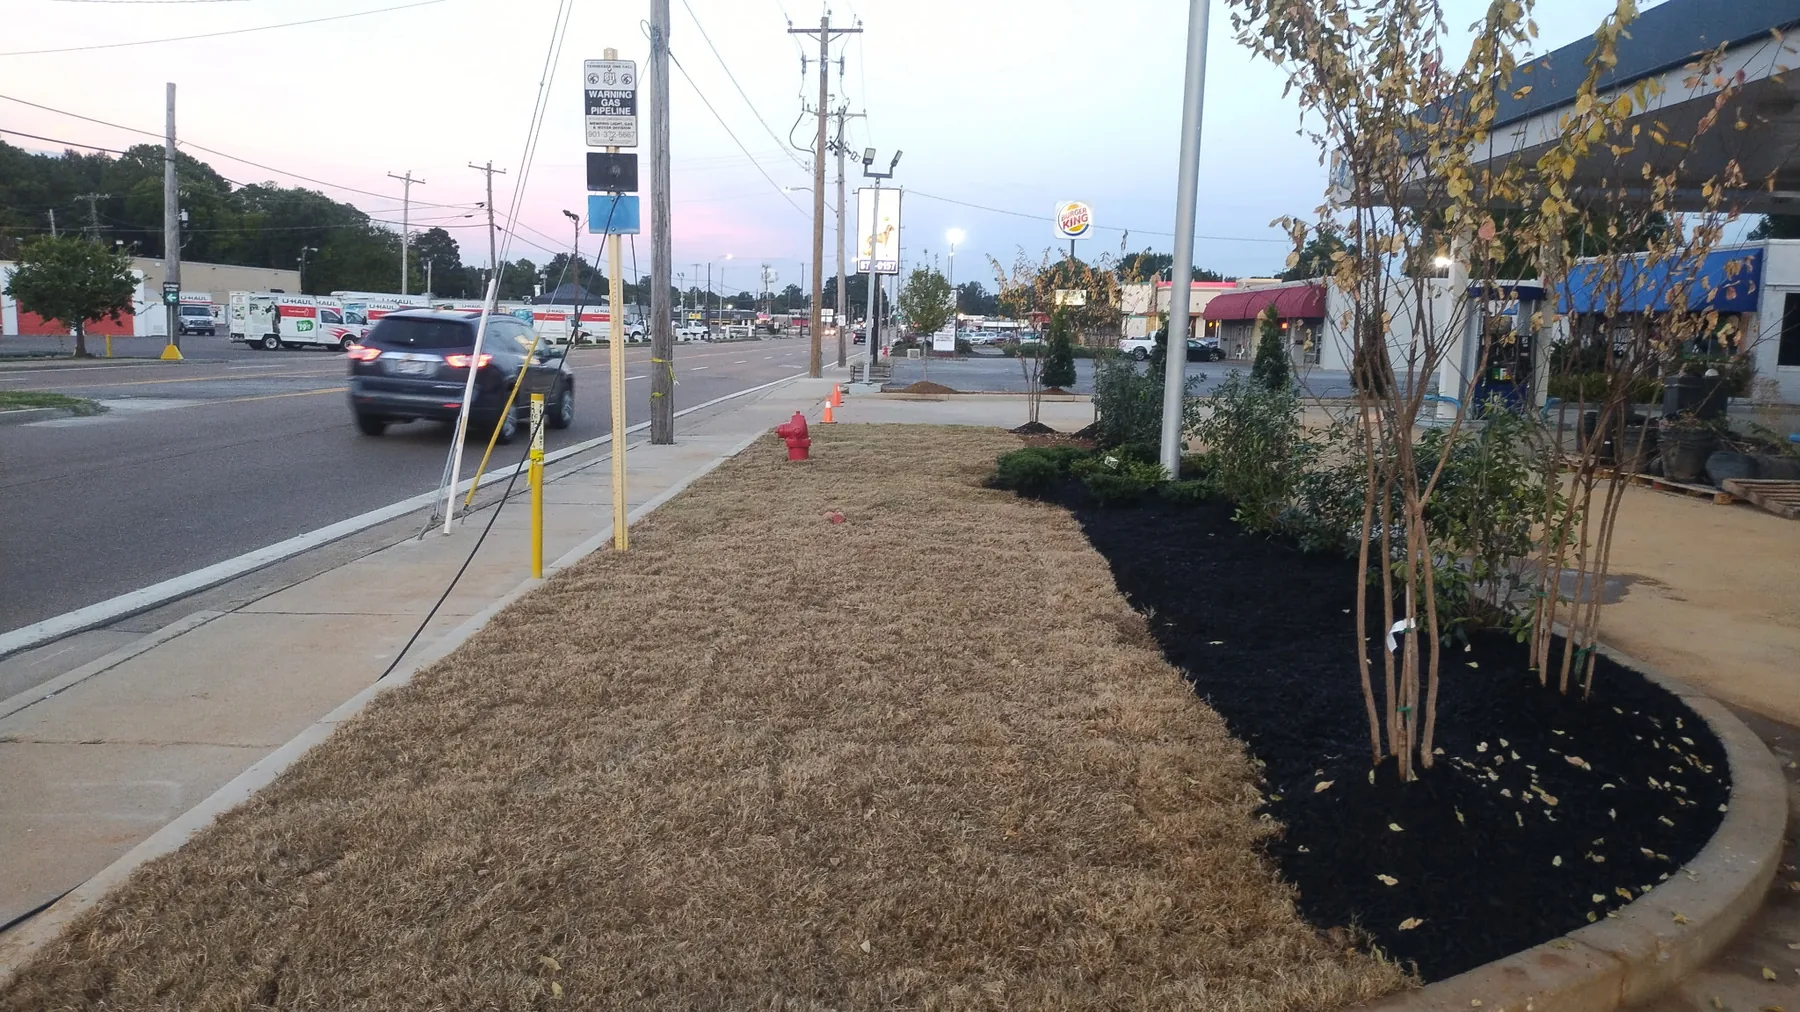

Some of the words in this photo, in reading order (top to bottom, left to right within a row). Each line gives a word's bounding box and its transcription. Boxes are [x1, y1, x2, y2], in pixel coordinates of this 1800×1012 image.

[589, 90, 632, 99] WARNING
[601, 98, 621, 107] GAS
[590, 106, 631, 115] PIPELINE
[1061, 207, 1087, 222] BURGER
[1062, 213, 1089, 230] KING
